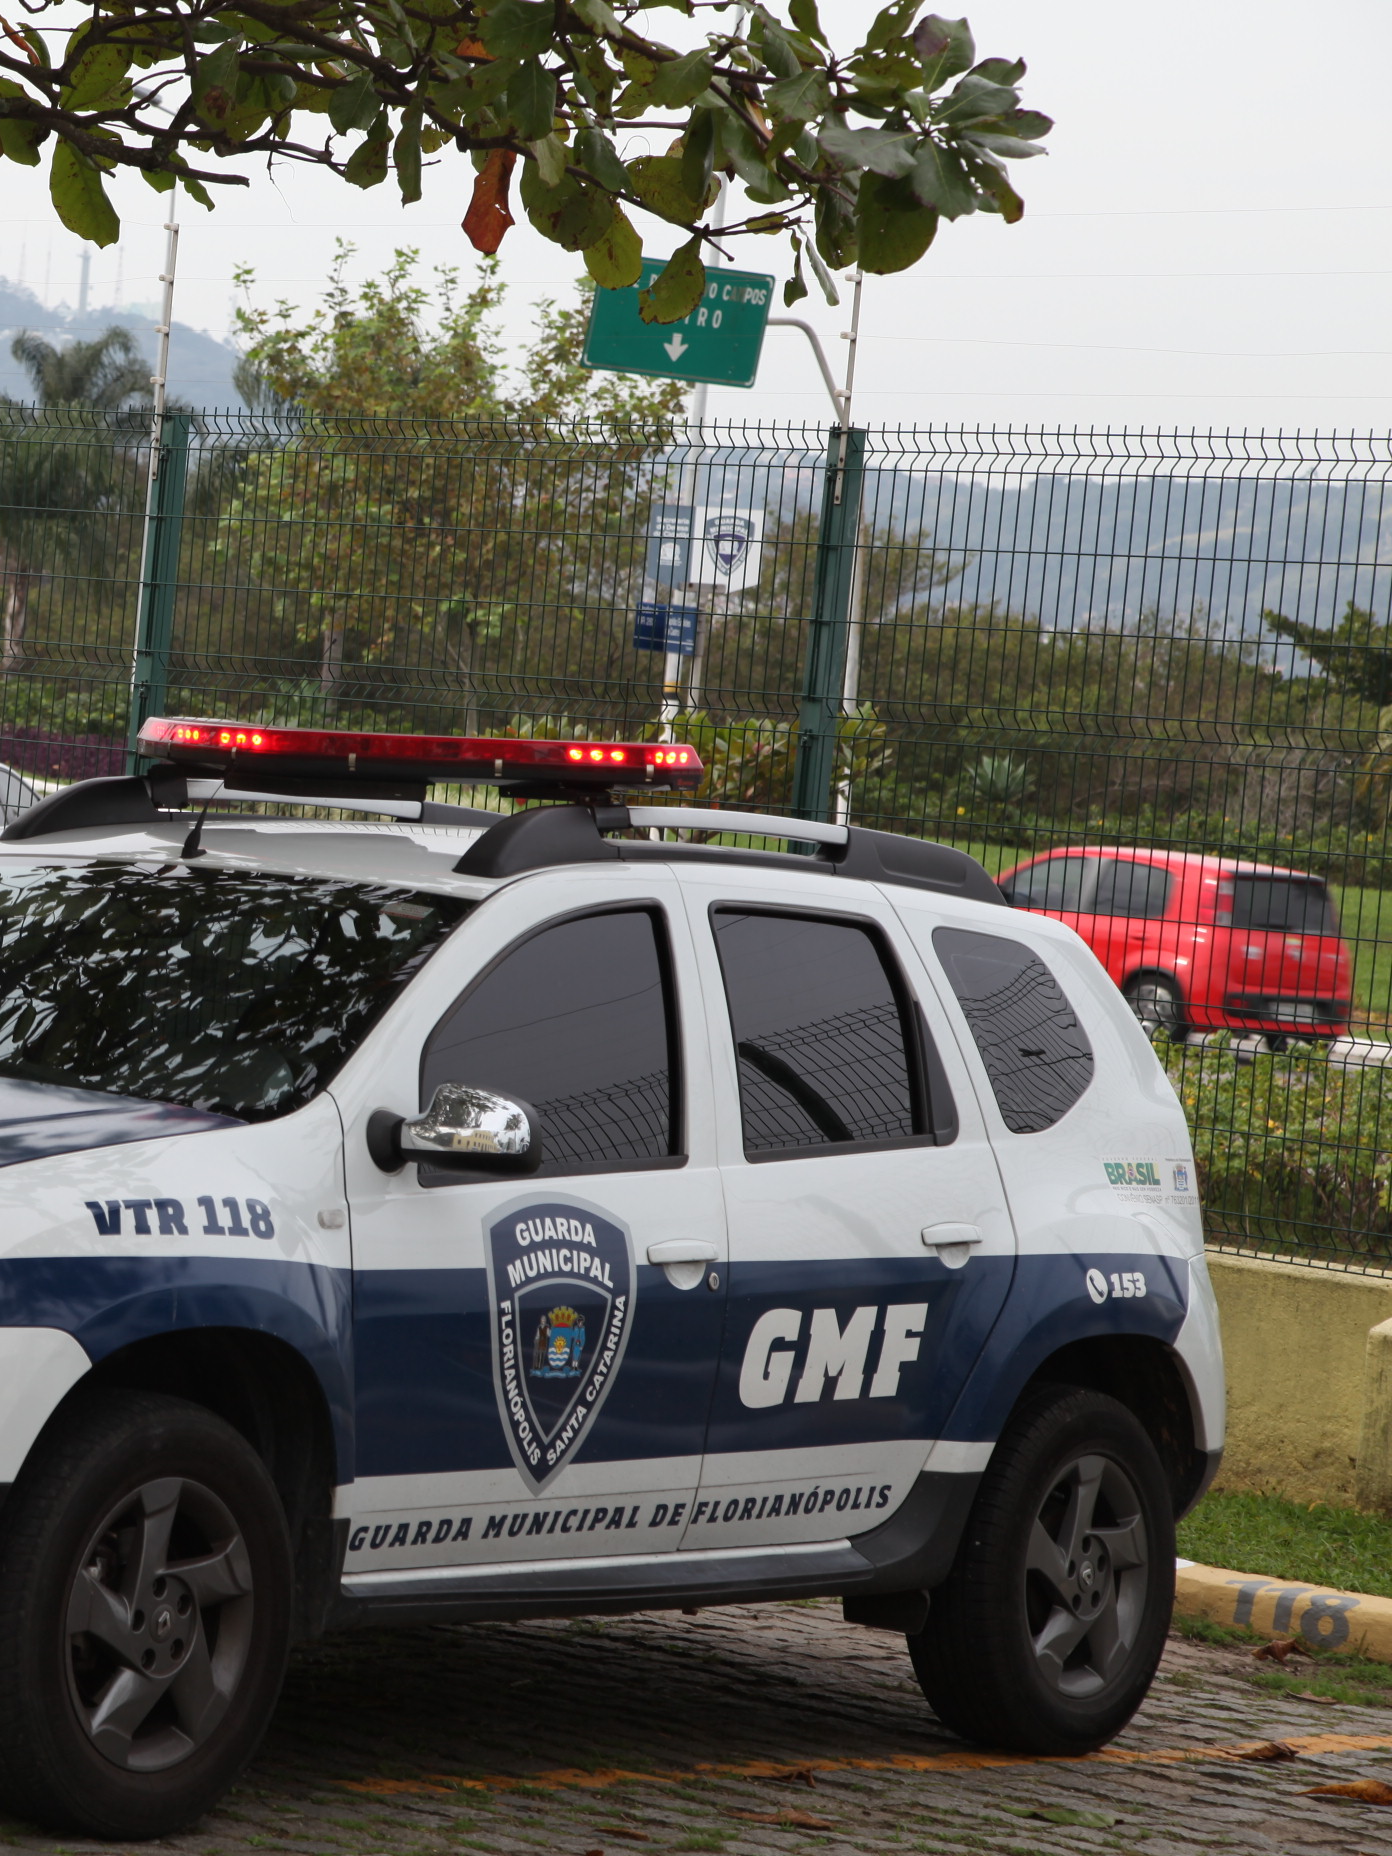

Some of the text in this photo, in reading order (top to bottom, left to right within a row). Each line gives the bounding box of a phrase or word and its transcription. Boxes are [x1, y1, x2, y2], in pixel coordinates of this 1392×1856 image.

[1103, 1163, 1161, 1186] BRASIL
[84, 1195, 275, 1240] VTR 118
[515, 1217, 597, 1248] GUARDA
[507, 1248, 614, 1288] MUNICIPAL
[1110, 1272, 1147, 1298] 153
[500, 1300, 541, 1466] FLORIANÓPOLIS
[546, 1406, 587, 1466] SANTA
[585, 1295, 626, 1402] CATARINA
[739, 1303, 928, 1409] GMF
[348, 1485, 892, 1551] GUARDA MUNICIPAL DE FLORIANÓPOLIS
[1225, 1579, 1361, 1650] 118
